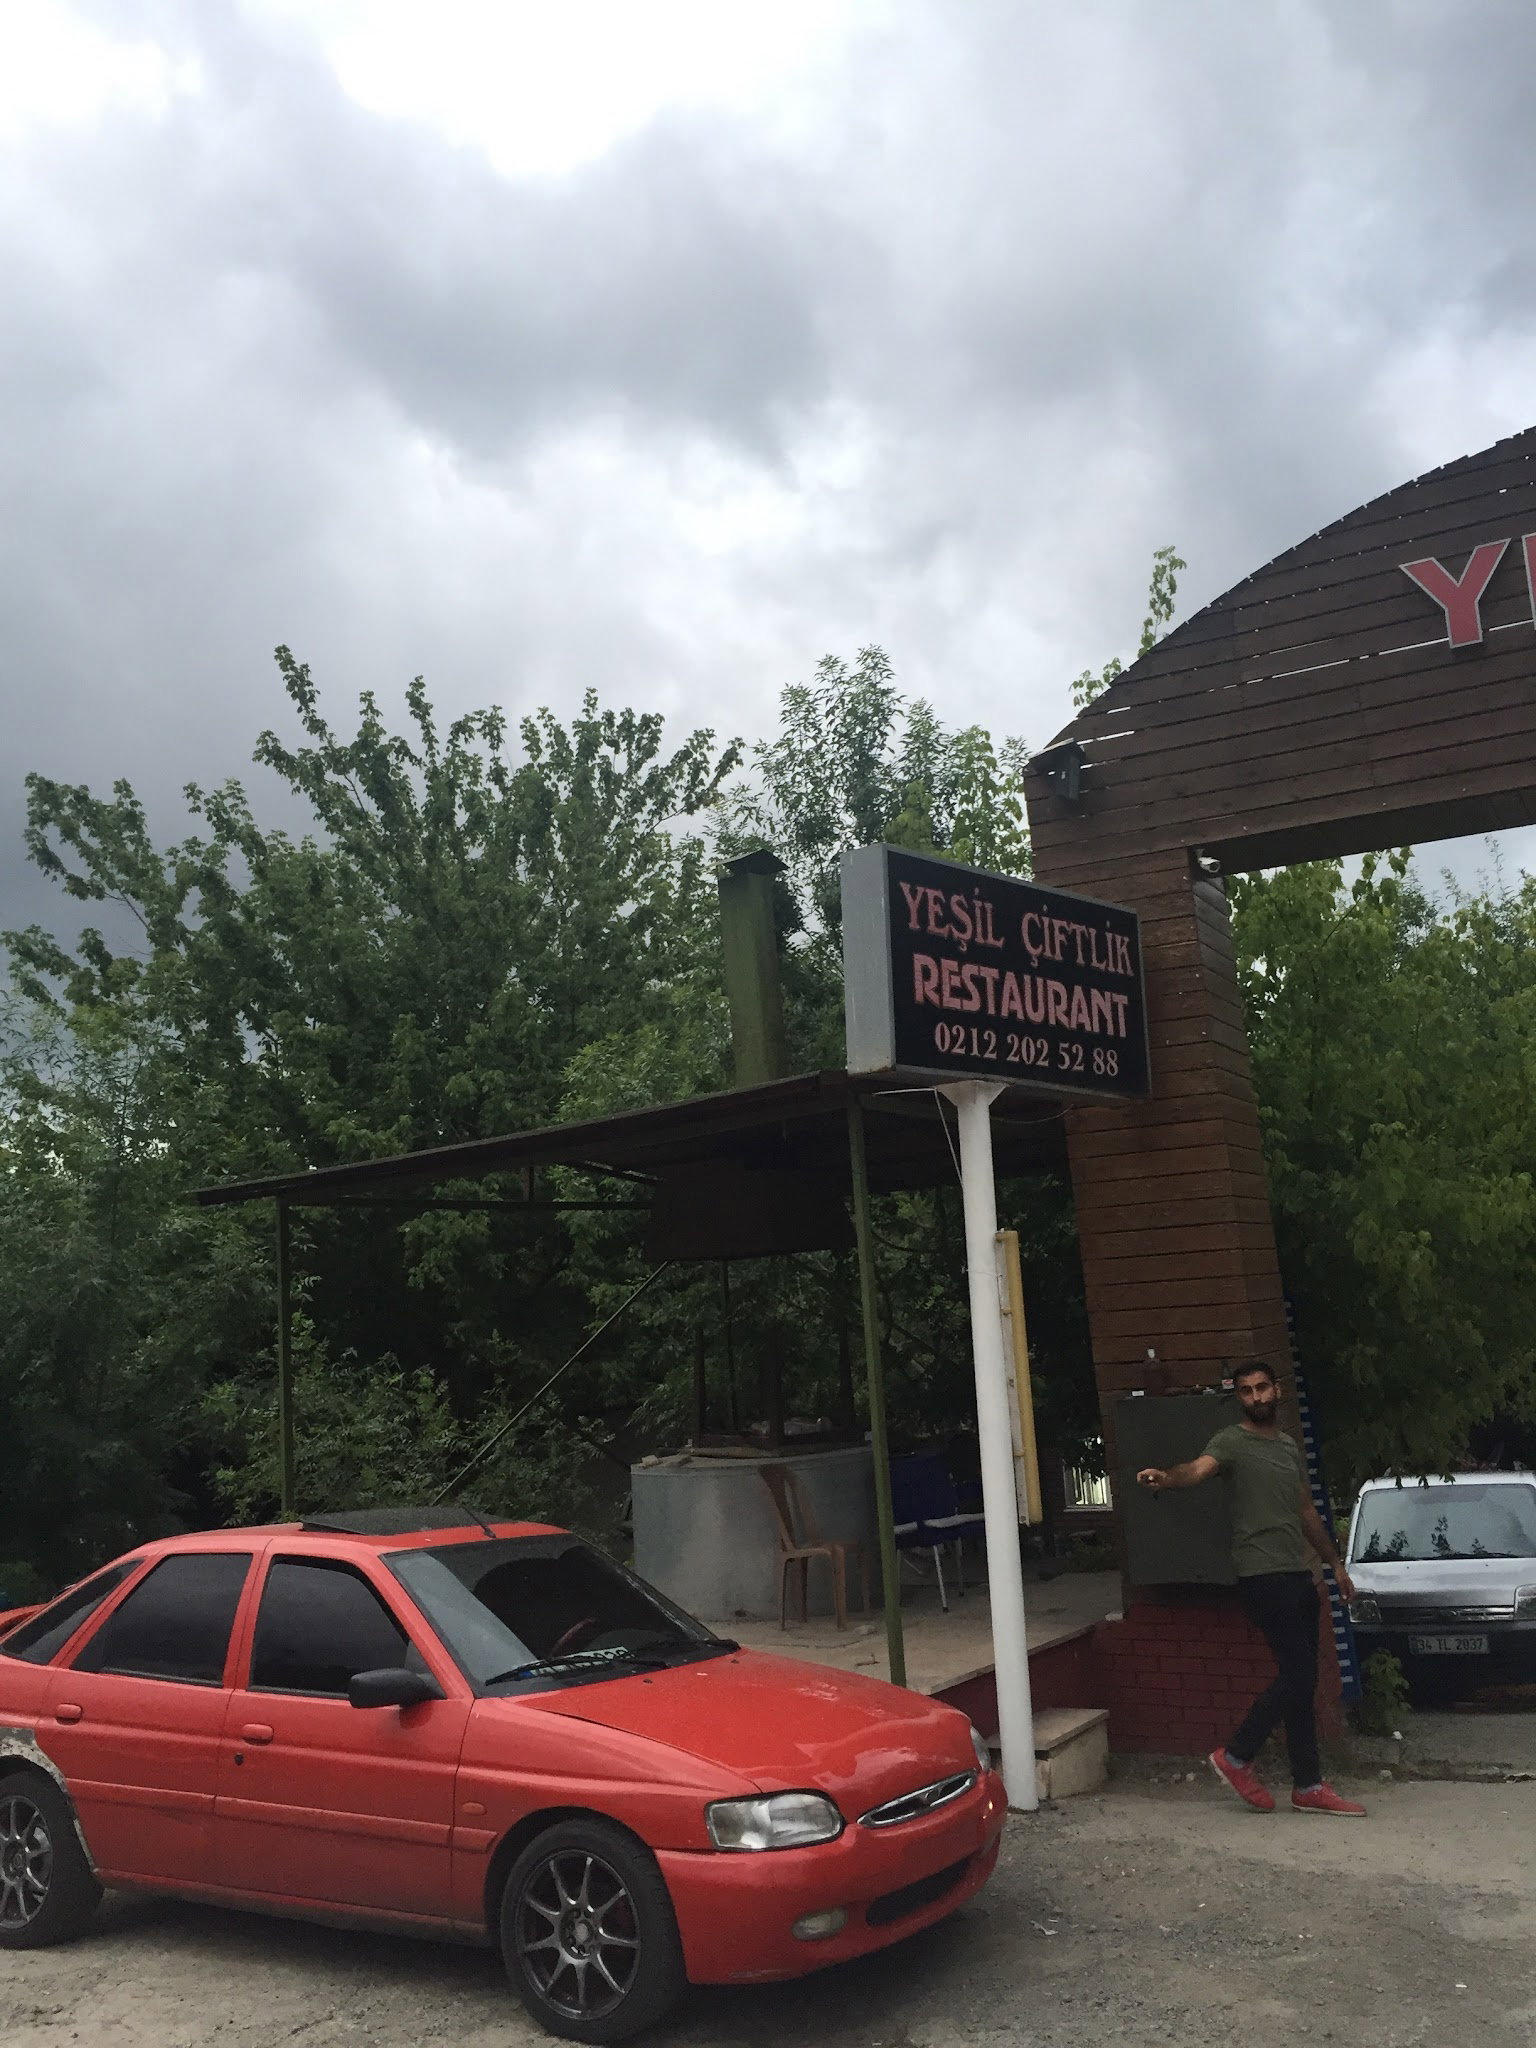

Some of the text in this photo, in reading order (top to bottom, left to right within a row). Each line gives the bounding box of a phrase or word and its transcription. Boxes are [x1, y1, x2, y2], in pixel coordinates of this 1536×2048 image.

[1399, 532, 1536, 649] Y
[899, 881, 1134, 977] YEŞİL ÇİFTLİK
[912, 953, 1128, 1038] RESTAURANT
[935, 1021, 1119, 1077] 0212 202 52 88
